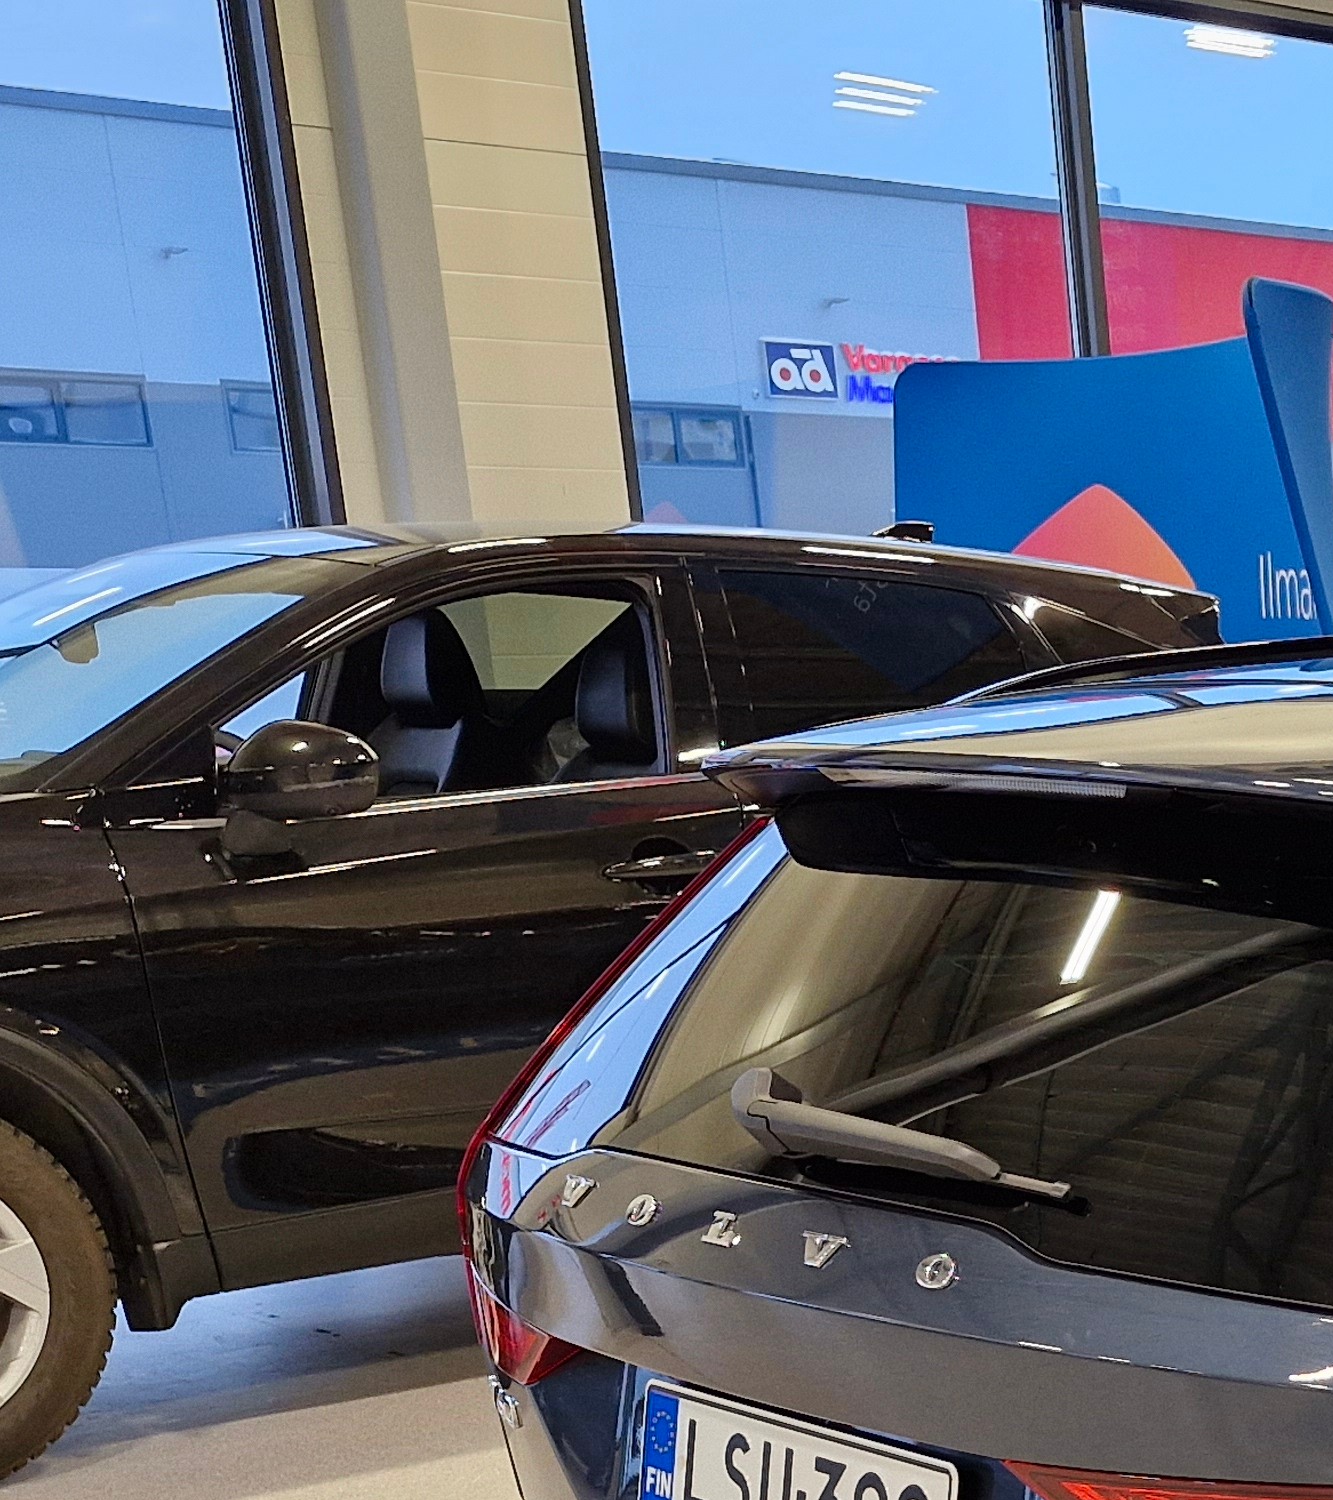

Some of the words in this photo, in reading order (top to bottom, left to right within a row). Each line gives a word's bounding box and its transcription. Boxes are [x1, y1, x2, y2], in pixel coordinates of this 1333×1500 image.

[1258, 550, 1318, 621] Ilma
[561, 1173, 961, 1290] VOLVO
[645, 1465, 673, 1499] FIN
